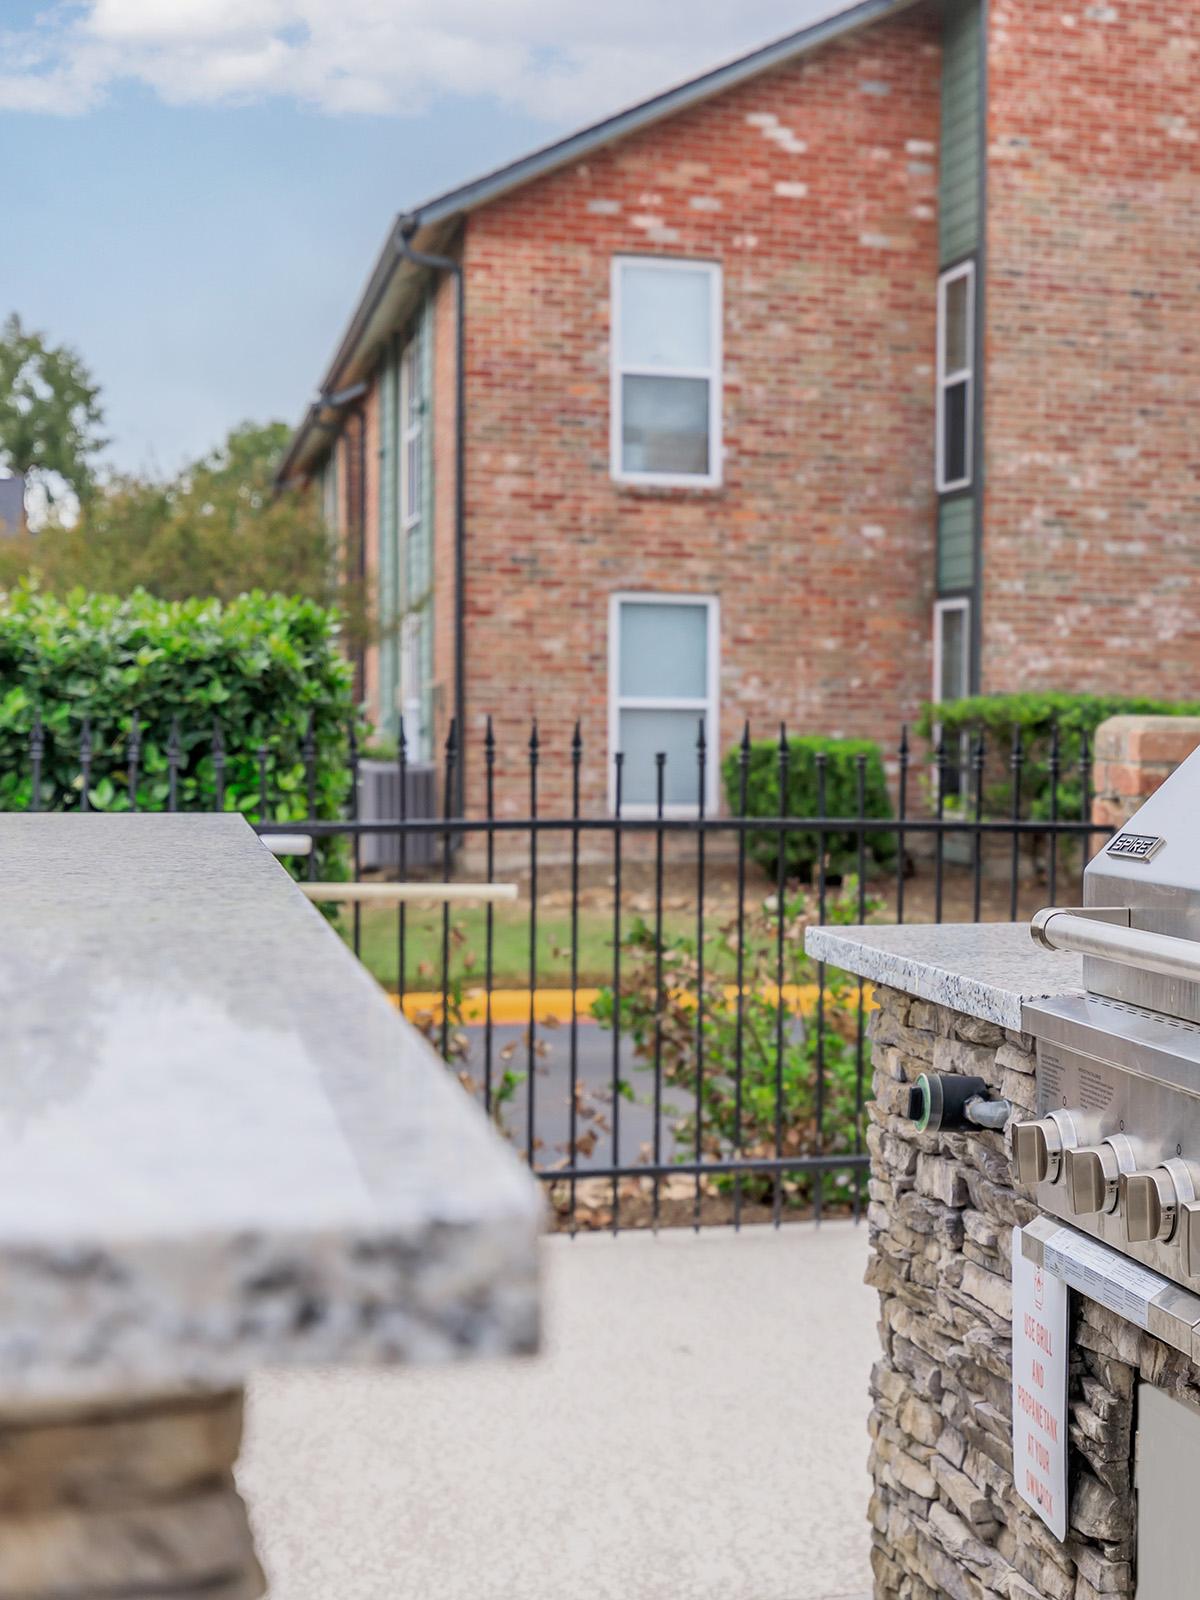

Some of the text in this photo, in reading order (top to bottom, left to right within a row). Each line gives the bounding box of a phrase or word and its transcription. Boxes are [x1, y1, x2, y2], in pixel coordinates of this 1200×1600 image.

[1112, 838, 1153, 854] SPIRE
[1036, 1323, 1053, 1357] GRILL
[1032, 1359, 1045, 1389] AND
[1017, 1384, 1058, 1444] PROPANE TANK
[1027, 1433, 1050, 1475] AT YOUR
